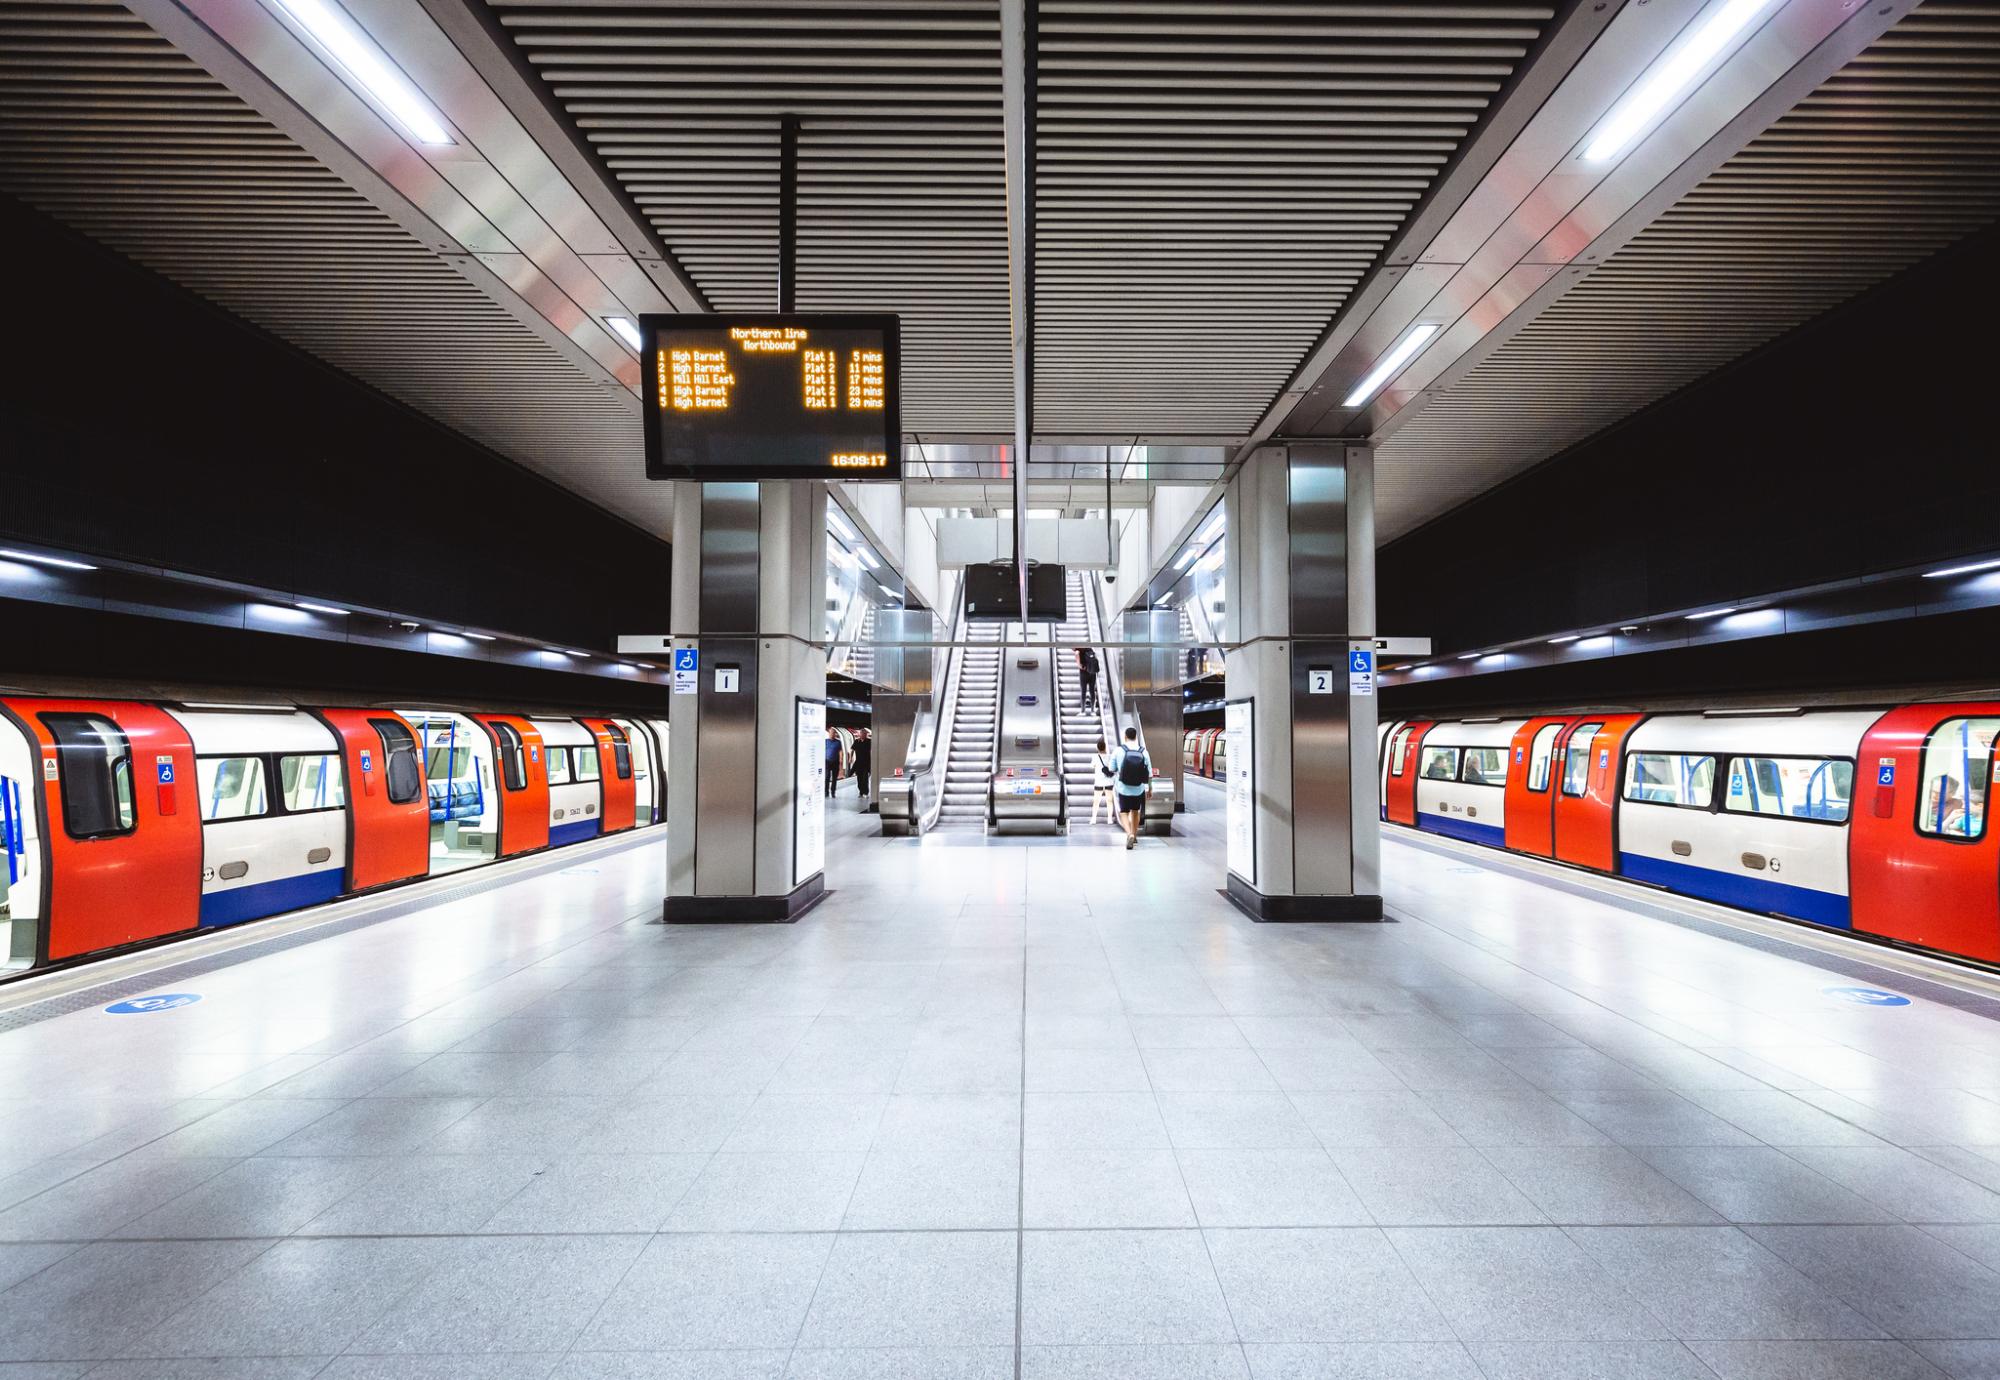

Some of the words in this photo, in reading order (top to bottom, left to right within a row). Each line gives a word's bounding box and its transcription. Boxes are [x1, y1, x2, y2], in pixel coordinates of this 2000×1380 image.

[731, 328, 782, 339] Northern
[785, 328, 807, 339] line
[743, 340, 796, 351] Northbound
[659, 351, 665, 361] 1
[672, 351, 691, 363] High
[693, 351, 726, 361] Barnet
[805, 351, 826, 362] Plat
[828, 351, 835, 362] 1
[853, 352, 860, 362] 5
[862, 352, 882, 362] mins
[659, 363, 665, 373] 2
[673, 363, 692, 374] High
[694, 363, 726, 373] Barnet
[805, 363, 826, 374] Plat
[828, 363, 835, 373] 2
[849, 364, 860, 373] 11
[862, 364, 883, 373] mins
[659, 374, 666, 384] 3
[673, 374, 691, 385] Mill
[693, 374, 710, 385] Hill
[712, 374, 735, 385] East
[805, 375, 826, 385] Plat
[829, 375, 835, 385] 1
[849, 375, 860, 385] 17
[863, 375, 883, 385] mins
[660, 386, 667, 396] 4
[673, 386, 693, 397] High
[695, 386, 727, 396] Barnet
[805, 386, 827, 396] Plat
[828, 386, 836, 396] 2
[863, 387, 883, 396] mins
[660, 397, 667, 407] 5
[674, 397, 693, 409] High
[695, 397, 728, 407] Barnet
[806, 398, 827, 408] Plat
[830, 398, 836, 408] 1
[863, 399, 884, 408] mins
[832, 456, 887, 467] 16:09:17
[725, 676, 728, 689] 1
[1316, 676, 1326, 690] 2
